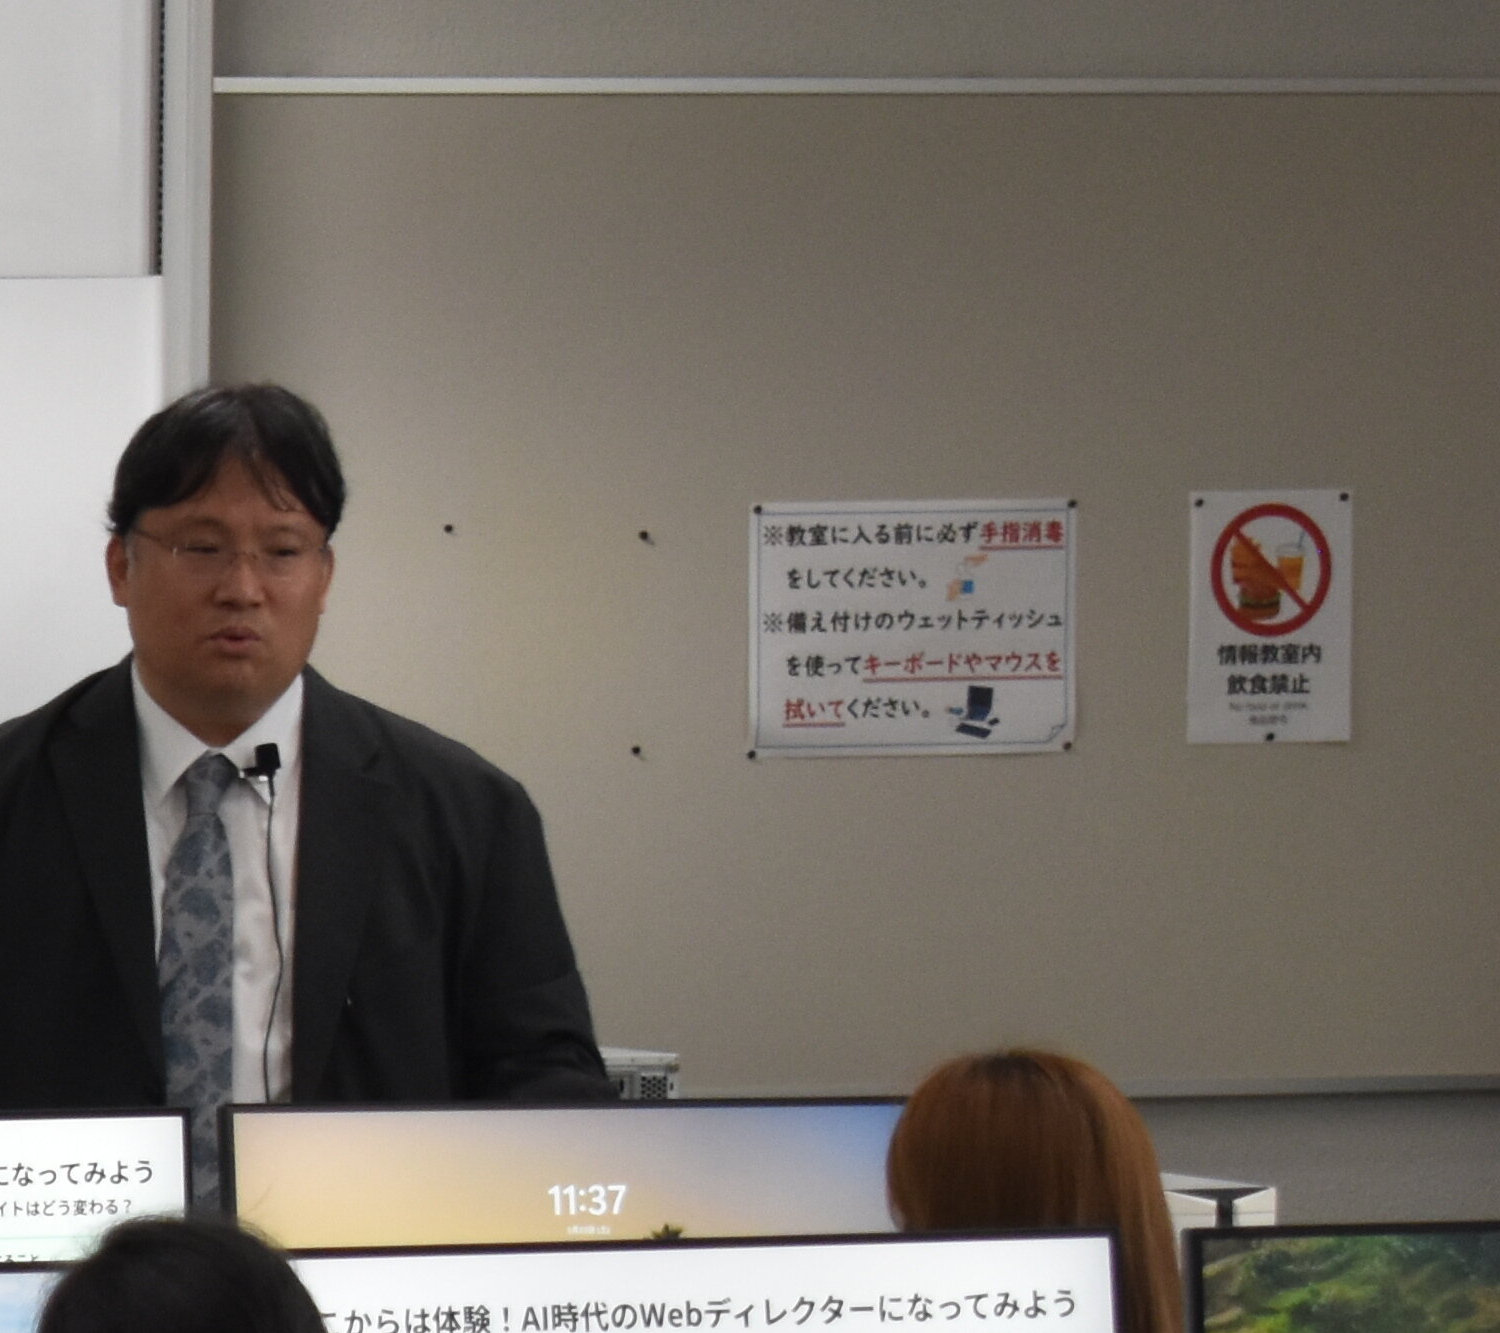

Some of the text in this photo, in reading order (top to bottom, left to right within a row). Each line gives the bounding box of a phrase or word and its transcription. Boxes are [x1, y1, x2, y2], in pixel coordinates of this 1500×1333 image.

[763, 520, 1064, 546] ※教室に入る前に必ず手指消毒
[787, 566, 928, 589] をしてください。
[763, 608, 1063, 633] ※備え付けのウェットティッシュ
[786, 652, 1061, 677] を使ってキーボードやマウスを
[1217, 643, 1322, 666] 情報教室内
[1227, 673, 1310, 695] 飲食禁止
[784, 698, 931, 720] 拭いてください。
[548, 1184, 628, 1216] 11:37
